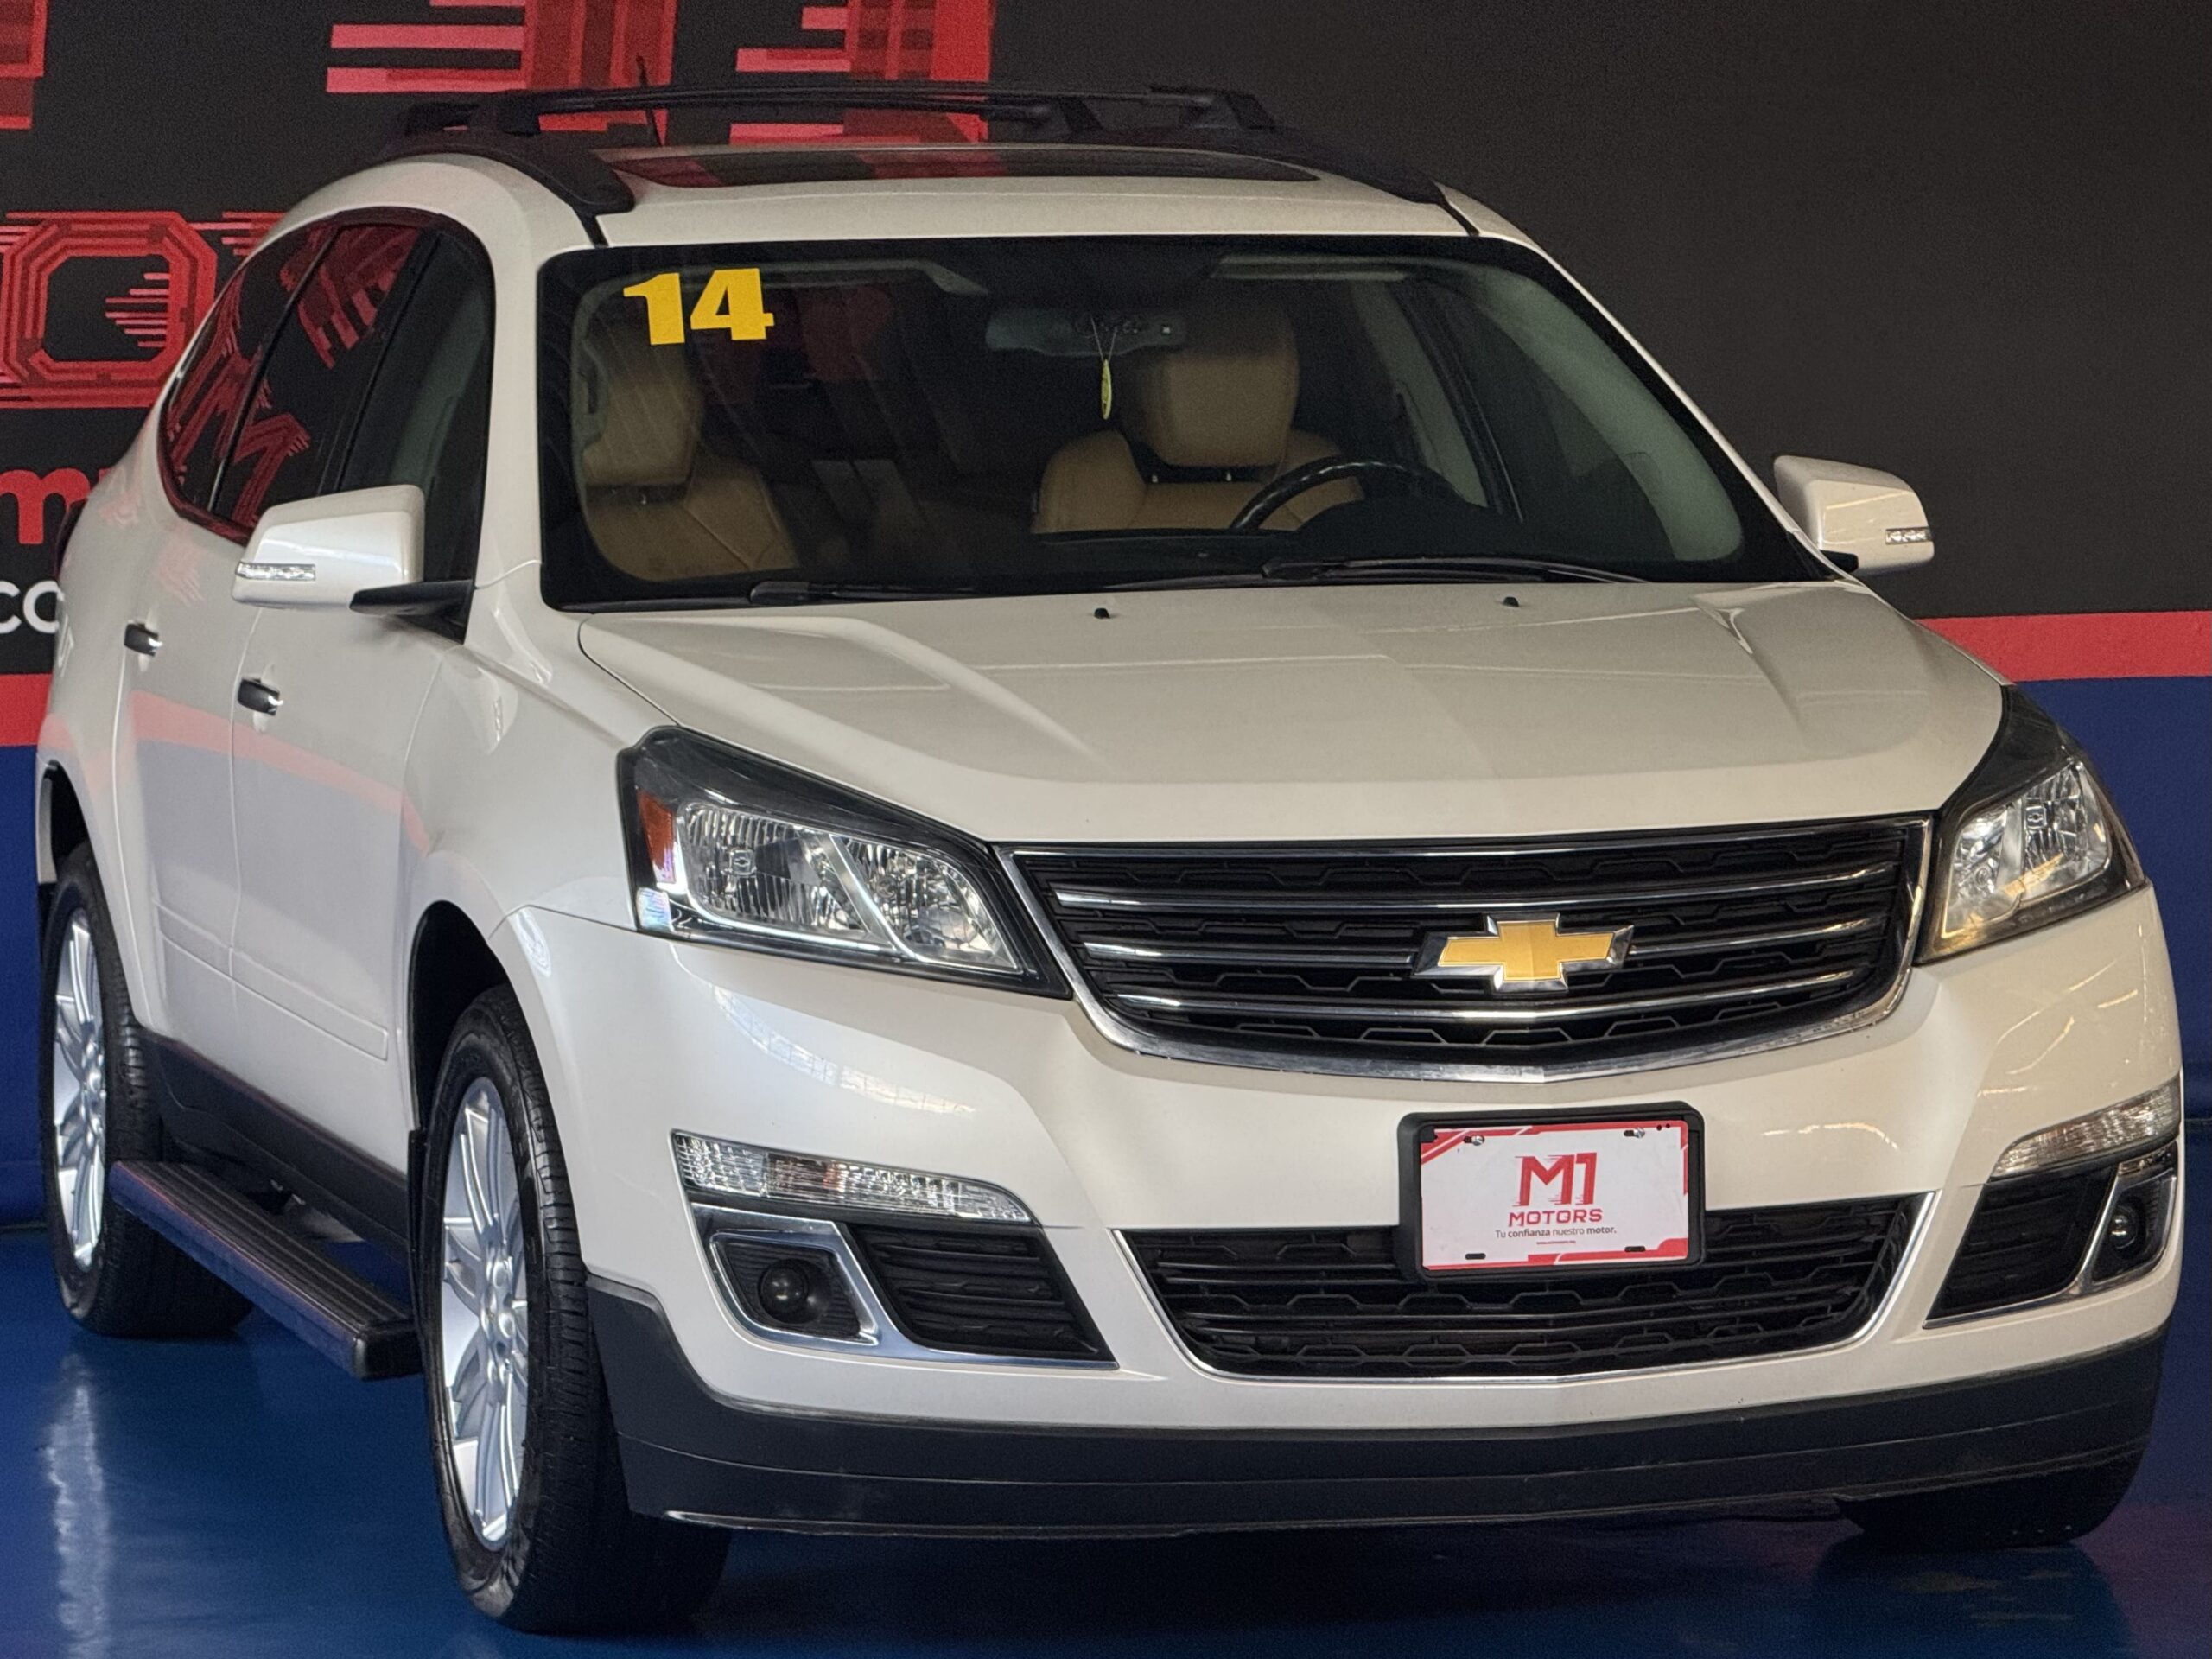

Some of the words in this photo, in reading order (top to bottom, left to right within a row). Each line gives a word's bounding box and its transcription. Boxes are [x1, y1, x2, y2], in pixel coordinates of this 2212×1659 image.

[623, 268, 775, 346] 14
[1512, 1152, 1597, 1207] M1
[1495, 1229, 1506, 1239] Tu
[1508, 1228, 1551, 1238] confianza
[1553, 1227, 1585, 1236] nuestro
[1586, 1225, 1618, 1235] motor.
[1508, 1208, 1603, 1227] MOTORS
